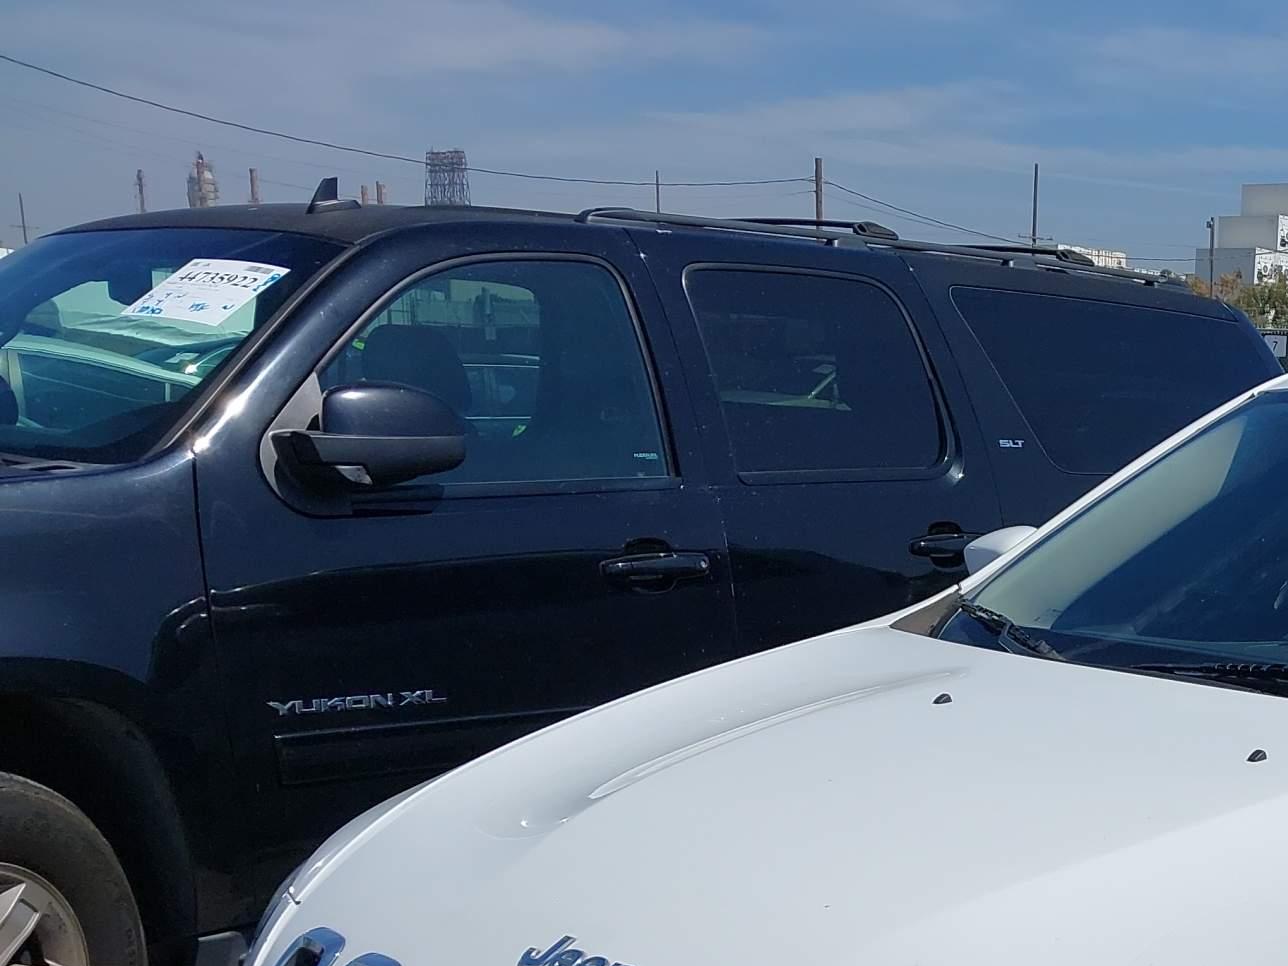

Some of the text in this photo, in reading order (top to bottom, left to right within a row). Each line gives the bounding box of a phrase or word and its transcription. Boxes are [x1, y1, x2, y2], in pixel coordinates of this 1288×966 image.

[179, 271, 258, 289] 44735922
[1272, 340, 1279, 351] 7
[999, 439, 1025, 448] SLT
[266, 689, 448, 716] YUKON XL
